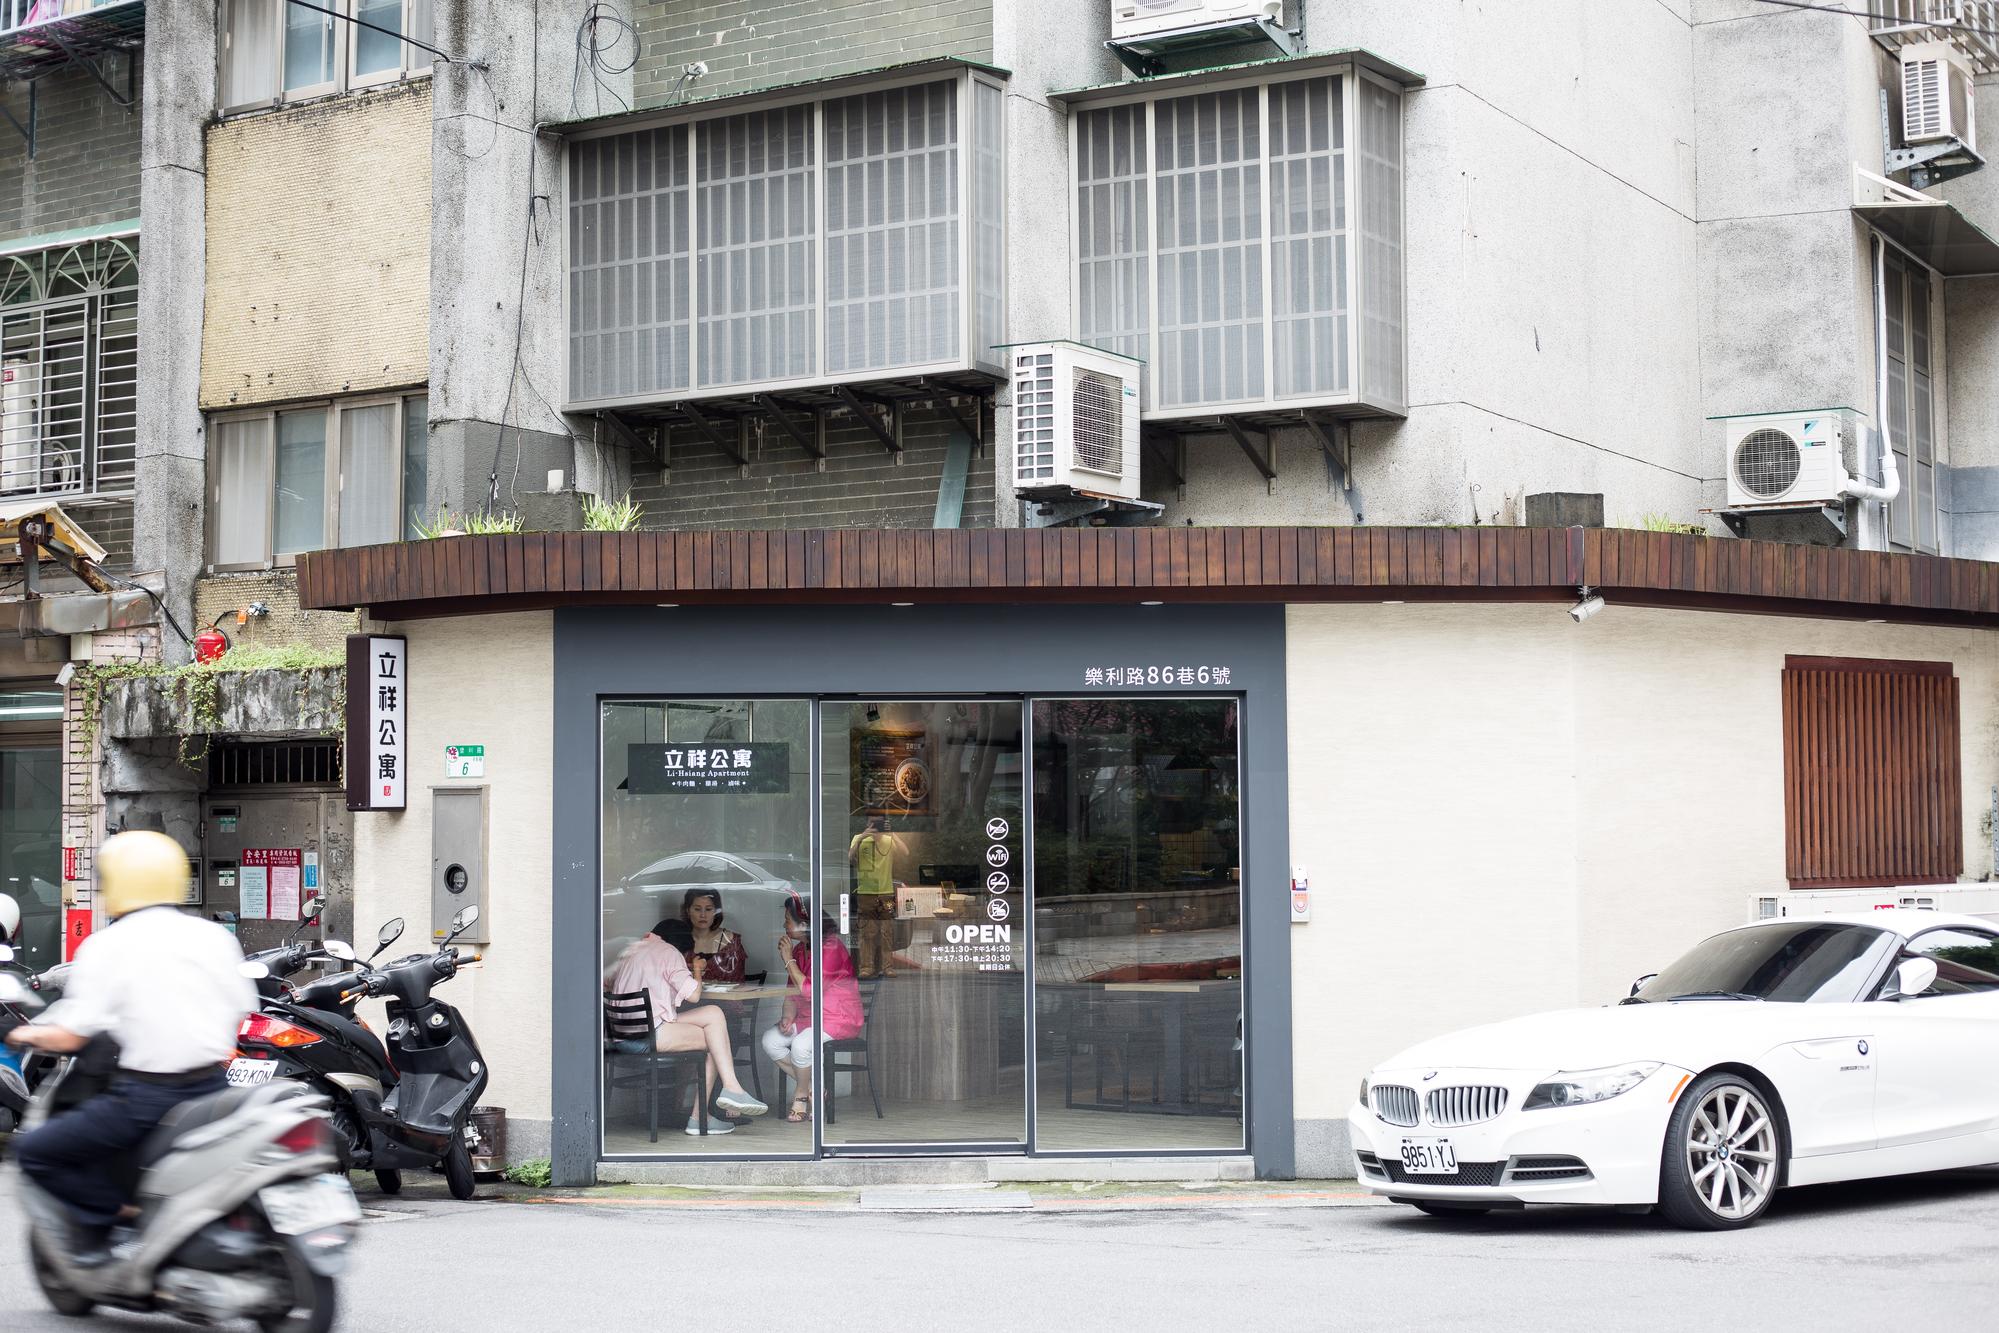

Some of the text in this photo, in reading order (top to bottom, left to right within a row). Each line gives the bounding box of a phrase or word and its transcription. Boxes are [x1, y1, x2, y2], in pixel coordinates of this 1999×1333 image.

[1085, 666, 1231, 686] 樂利路86巷6號
[378, 652, 397, 779] 立祥公寓
[462, 762, 469, 775] 6
[664, 749, 752, 769] 立祥公寓
[945, 924, 1011, 944] OPEN
